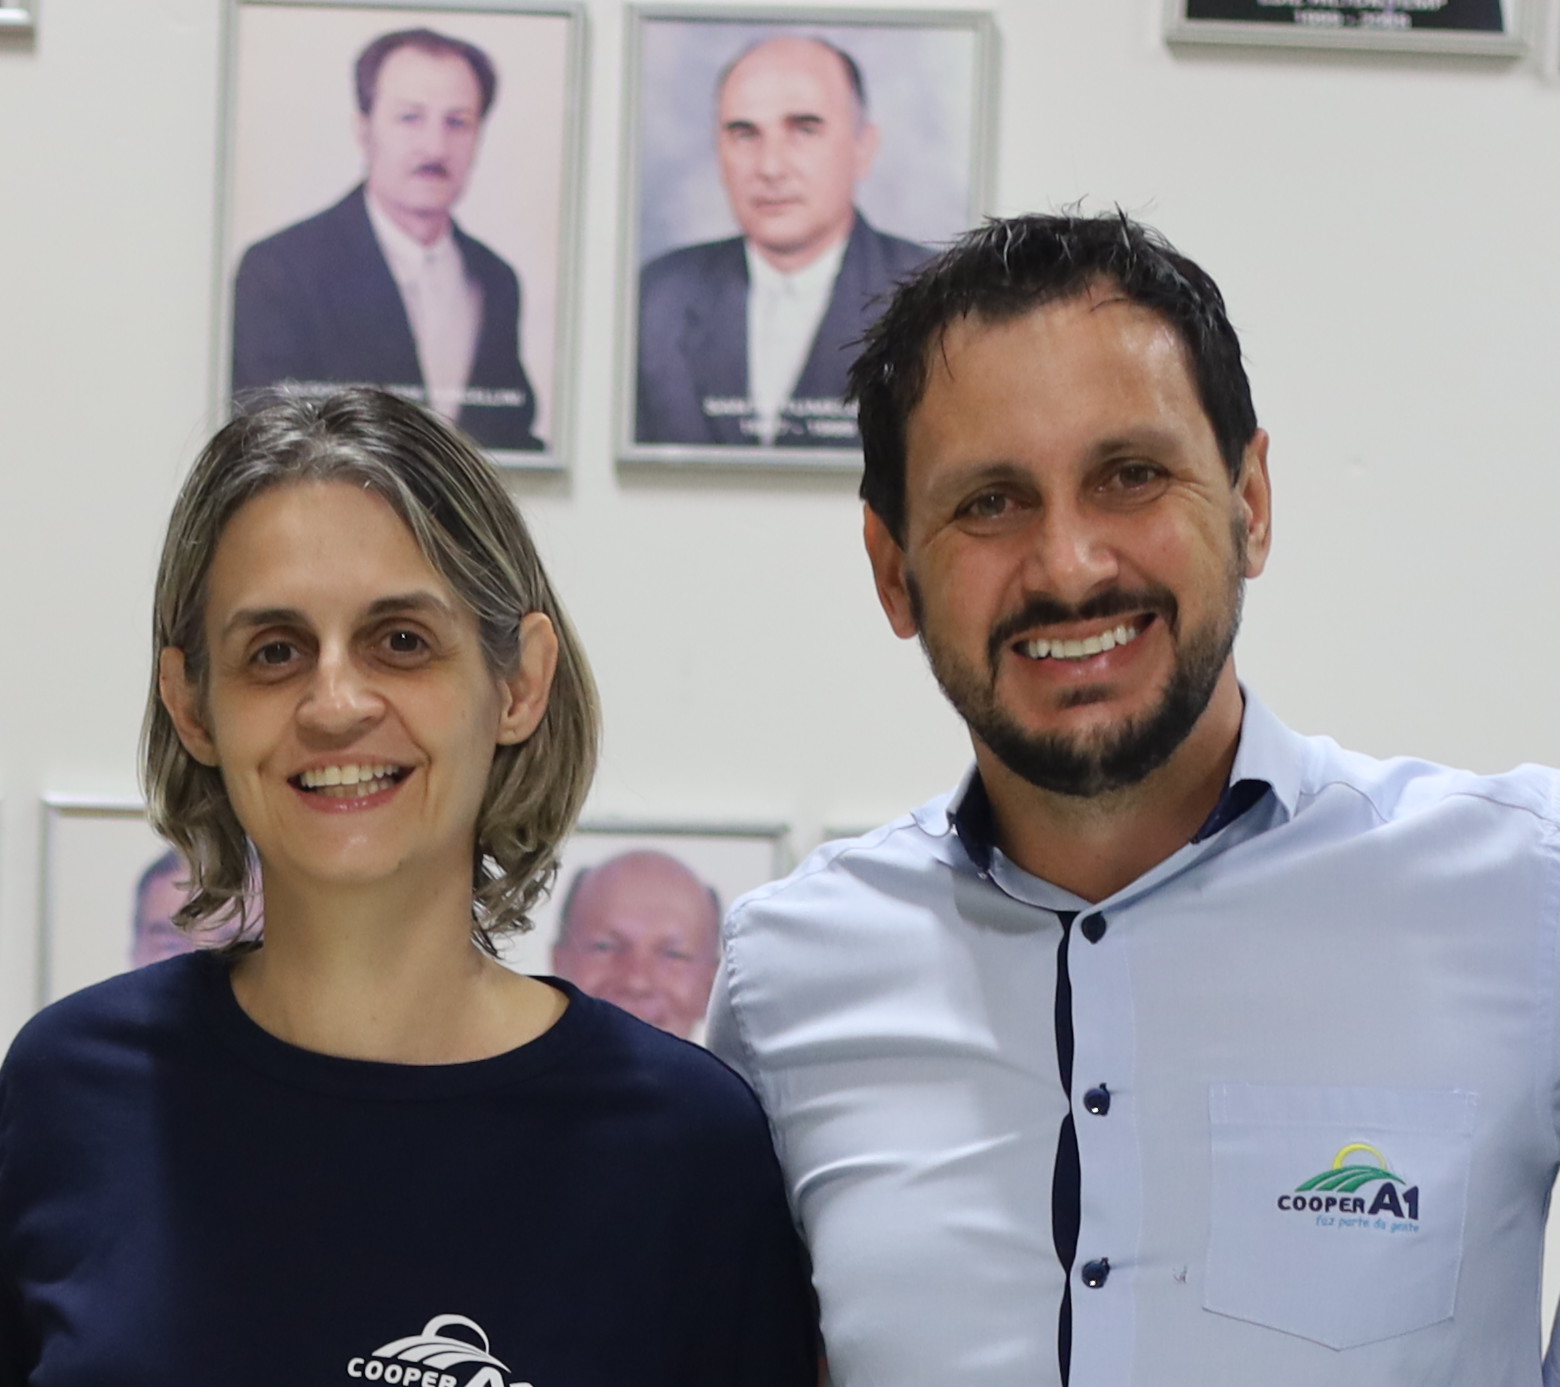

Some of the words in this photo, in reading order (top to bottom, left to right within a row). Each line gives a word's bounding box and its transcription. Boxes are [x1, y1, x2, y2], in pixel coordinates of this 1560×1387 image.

[1277, 1195, 1365, 1214] COOPER
[1367, 1182, 1419, 1221] A1
[1338, 1217, 1369, 1229] parte
